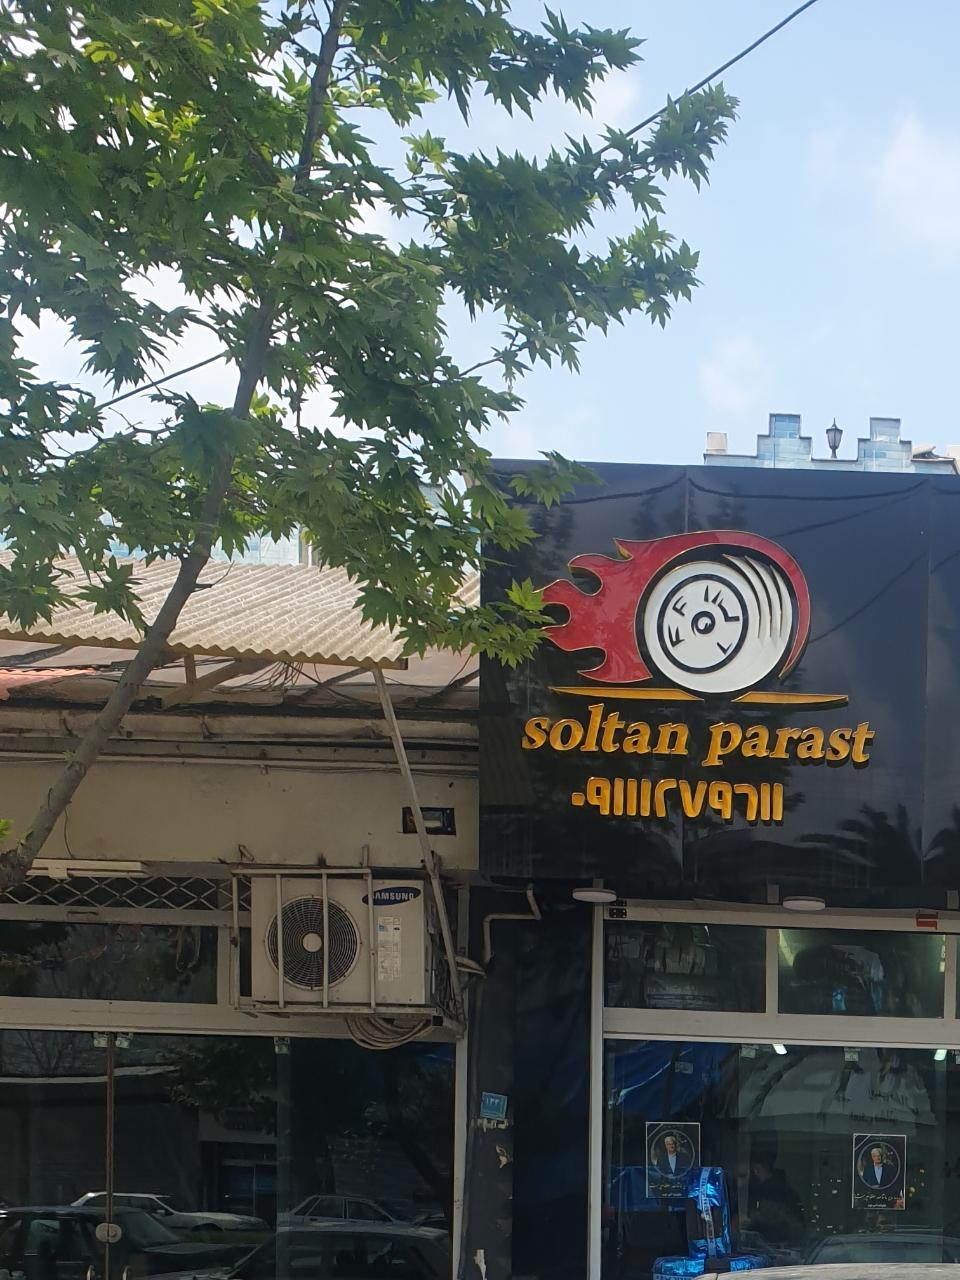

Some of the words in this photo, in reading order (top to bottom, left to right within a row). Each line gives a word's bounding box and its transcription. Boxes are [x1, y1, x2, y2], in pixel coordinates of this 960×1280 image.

[522, 702, 690, 756] soltan
[702, 722, 874, 768] parast
[372, 891, 415, 901] AMSUNG
